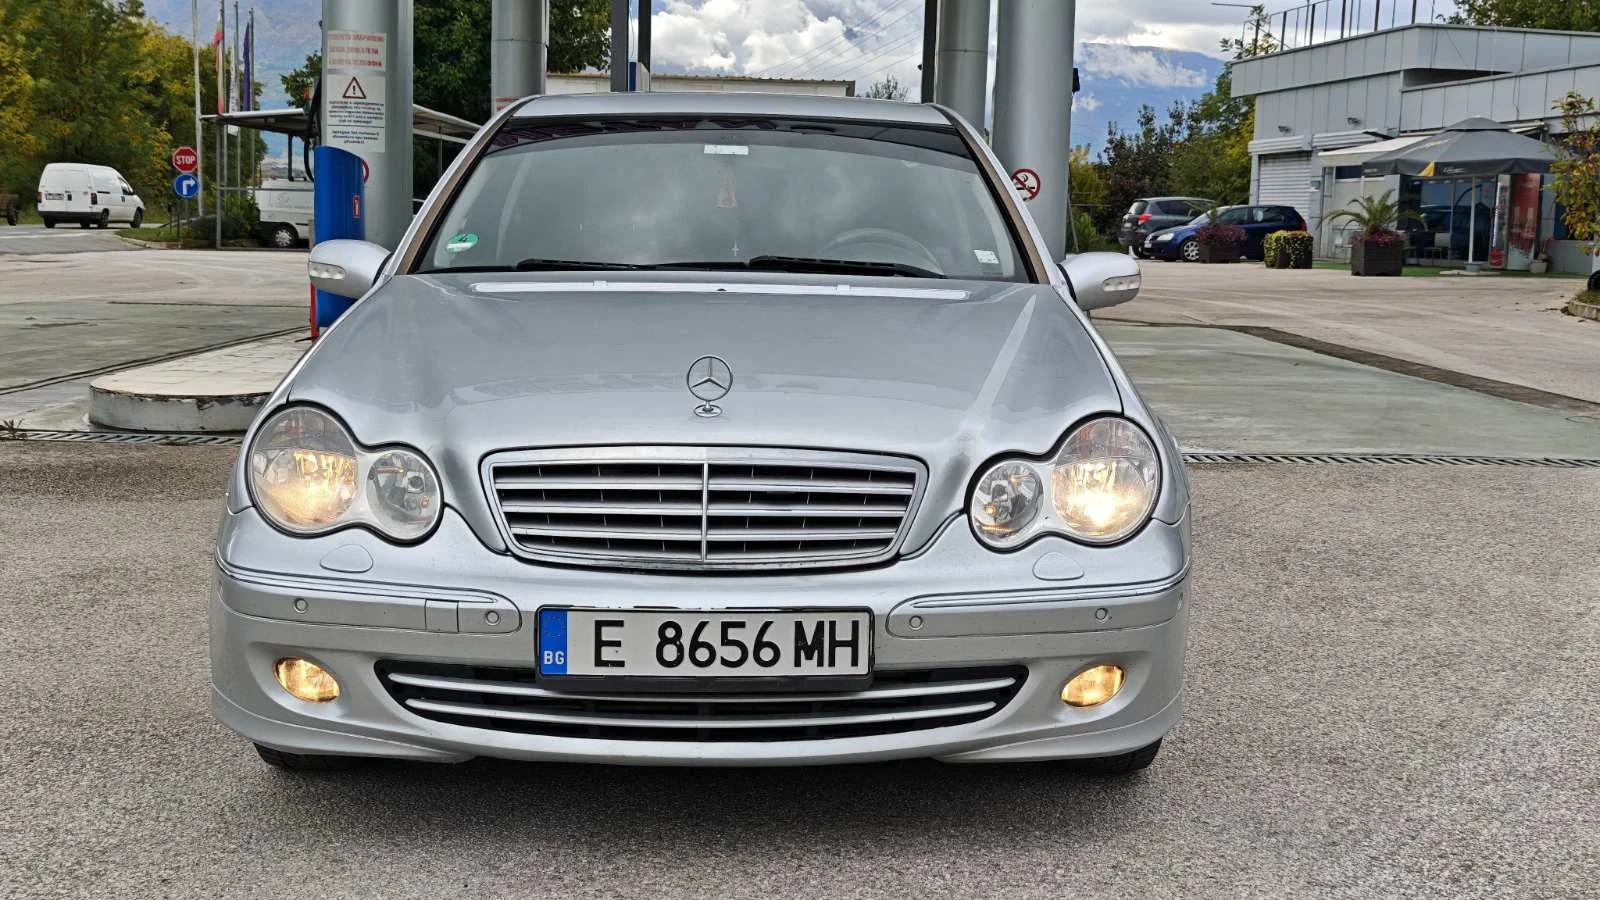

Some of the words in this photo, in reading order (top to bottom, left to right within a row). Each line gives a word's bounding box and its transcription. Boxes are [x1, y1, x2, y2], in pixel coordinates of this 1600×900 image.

[176, 155, 195, 165] STOP
[594, 620, 625, 667] E
[656, 621, 781, 668] 8656
[794, 620, 860, 667] MH
[544, 650, 565, 665] BG
